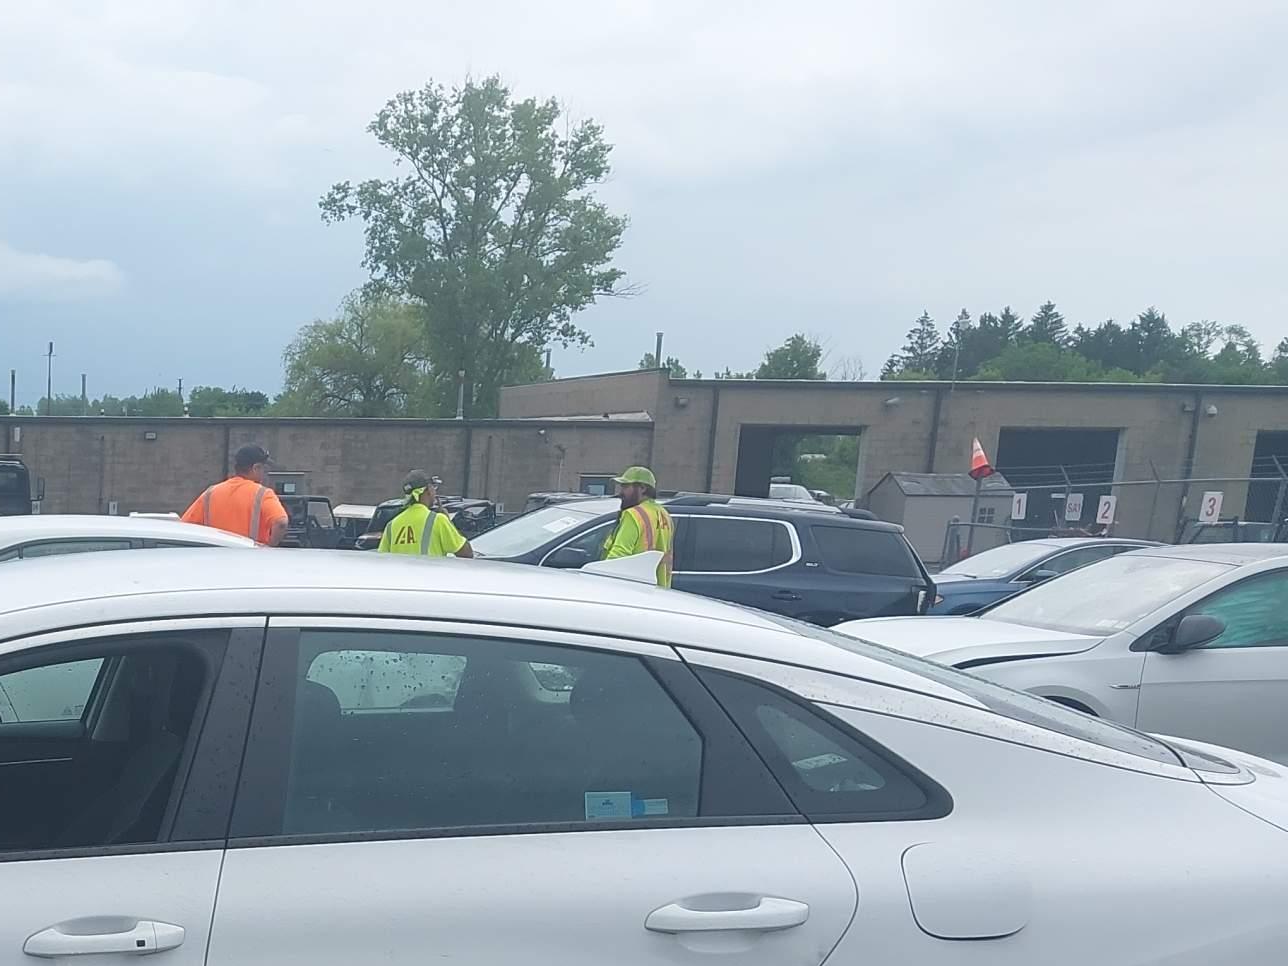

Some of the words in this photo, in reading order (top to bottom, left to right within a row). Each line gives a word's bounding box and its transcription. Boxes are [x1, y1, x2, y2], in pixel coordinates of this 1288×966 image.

[1016, 498, 1022, 515] 1
[1101, 501, 1111, 519] 2
[1206, 497, 1216, 517] 3
